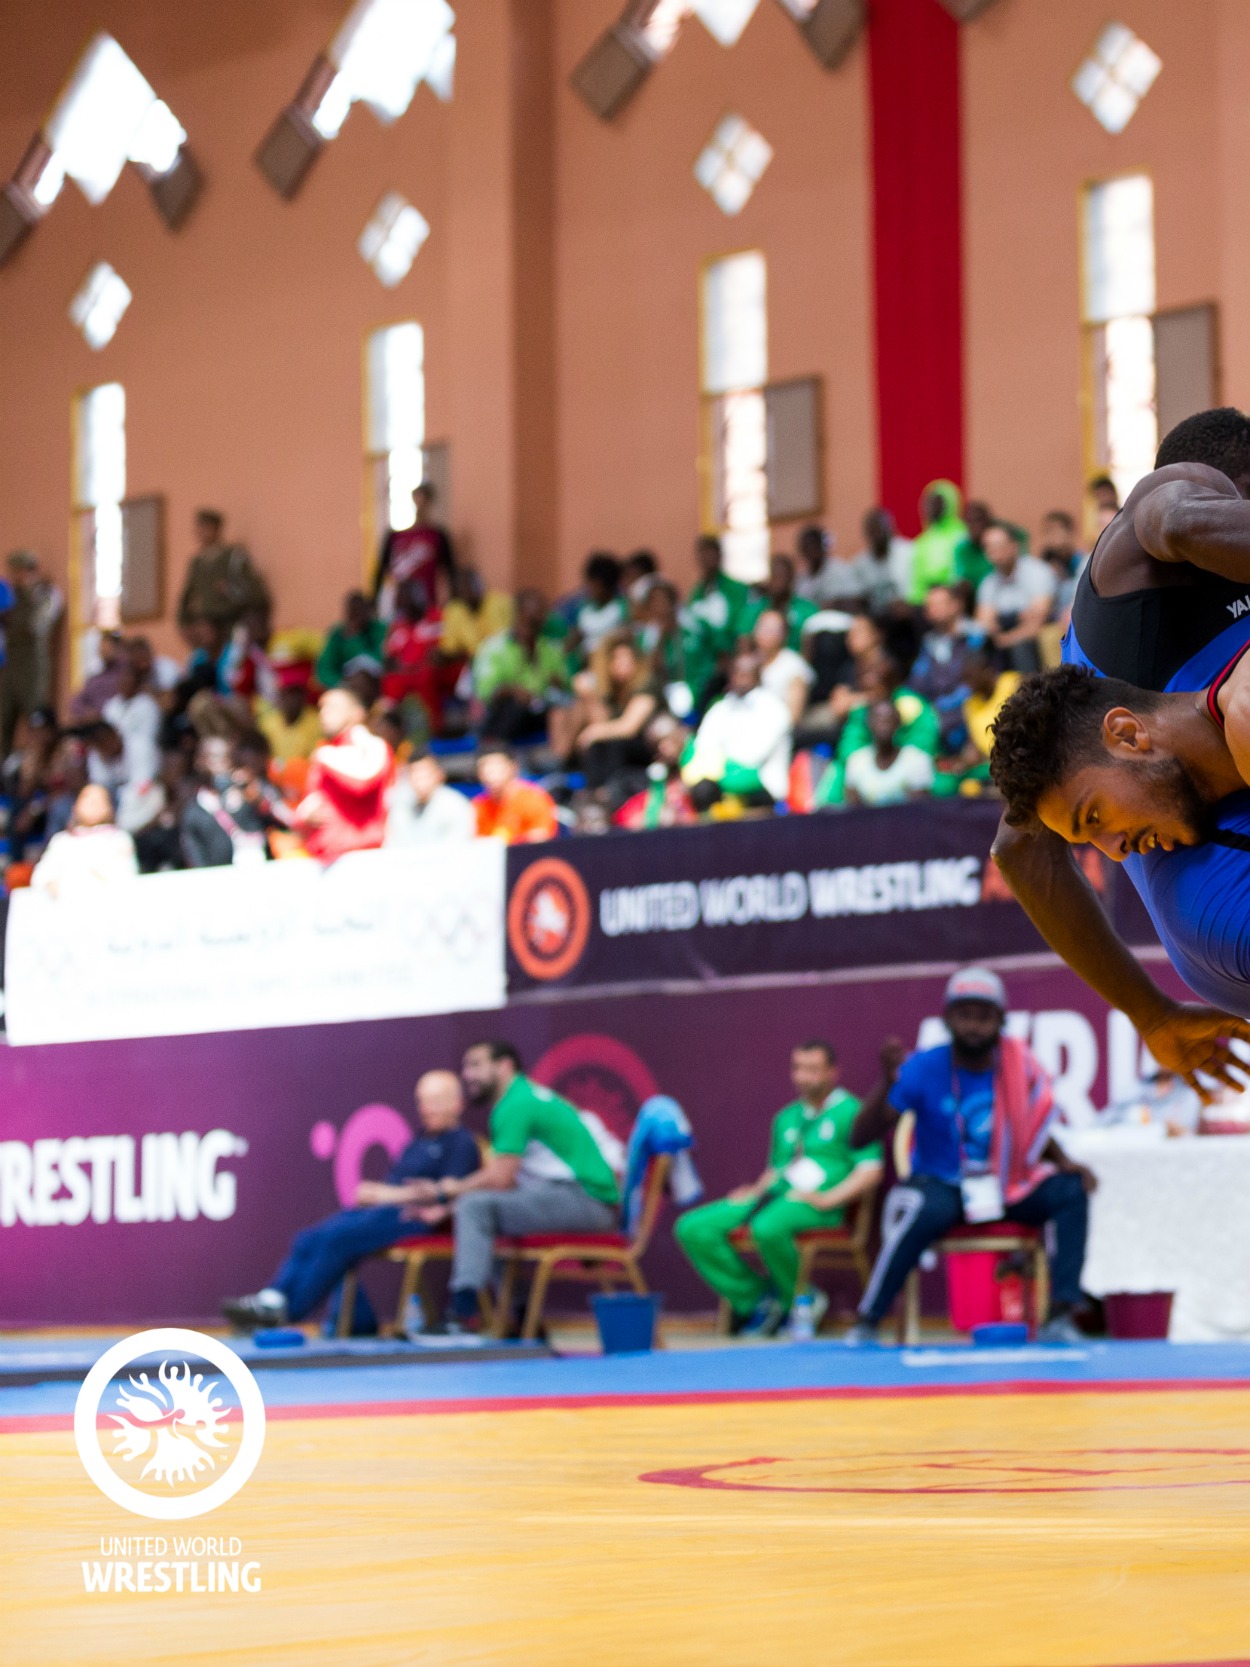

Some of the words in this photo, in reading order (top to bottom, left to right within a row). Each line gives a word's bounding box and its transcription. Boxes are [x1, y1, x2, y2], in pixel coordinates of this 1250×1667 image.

[600, 881, 699, 937] UNITED
[700, 871, 807, 927] WORLD
[807, 856, 981, 919] WRESTLING
